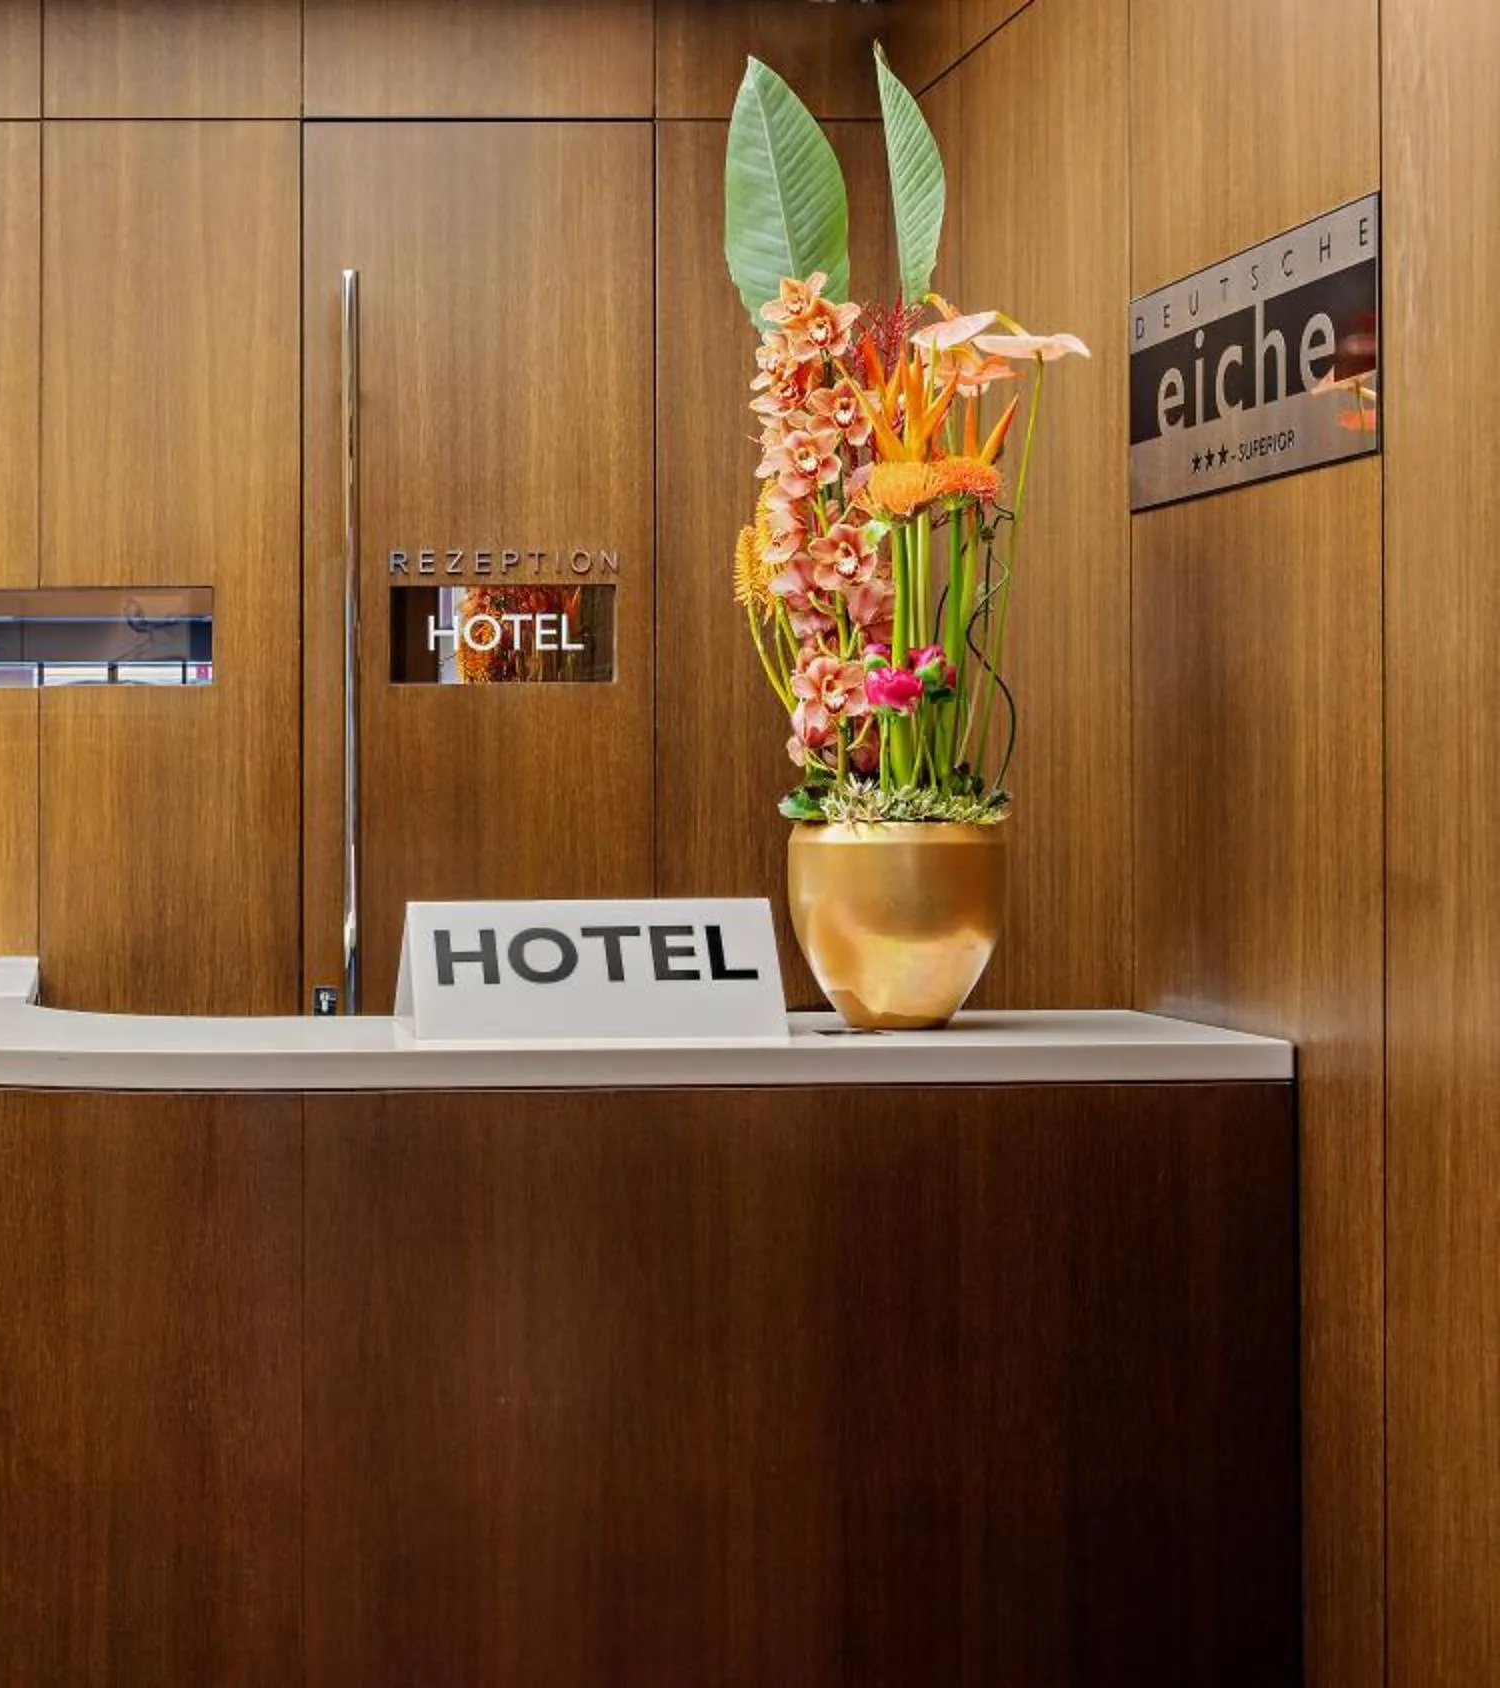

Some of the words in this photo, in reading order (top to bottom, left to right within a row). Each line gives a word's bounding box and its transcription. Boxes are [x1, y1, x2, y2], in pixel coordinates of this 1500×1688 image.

[1134, 217, 1369, 340] DEUTSCHE
[1157, 298, 1336, 440] eiche
[389, 548, 621, 575] REZEPTION
[428, 613, 585, 651] HOTEL
[433, 925, 760, 986] HOTEL
